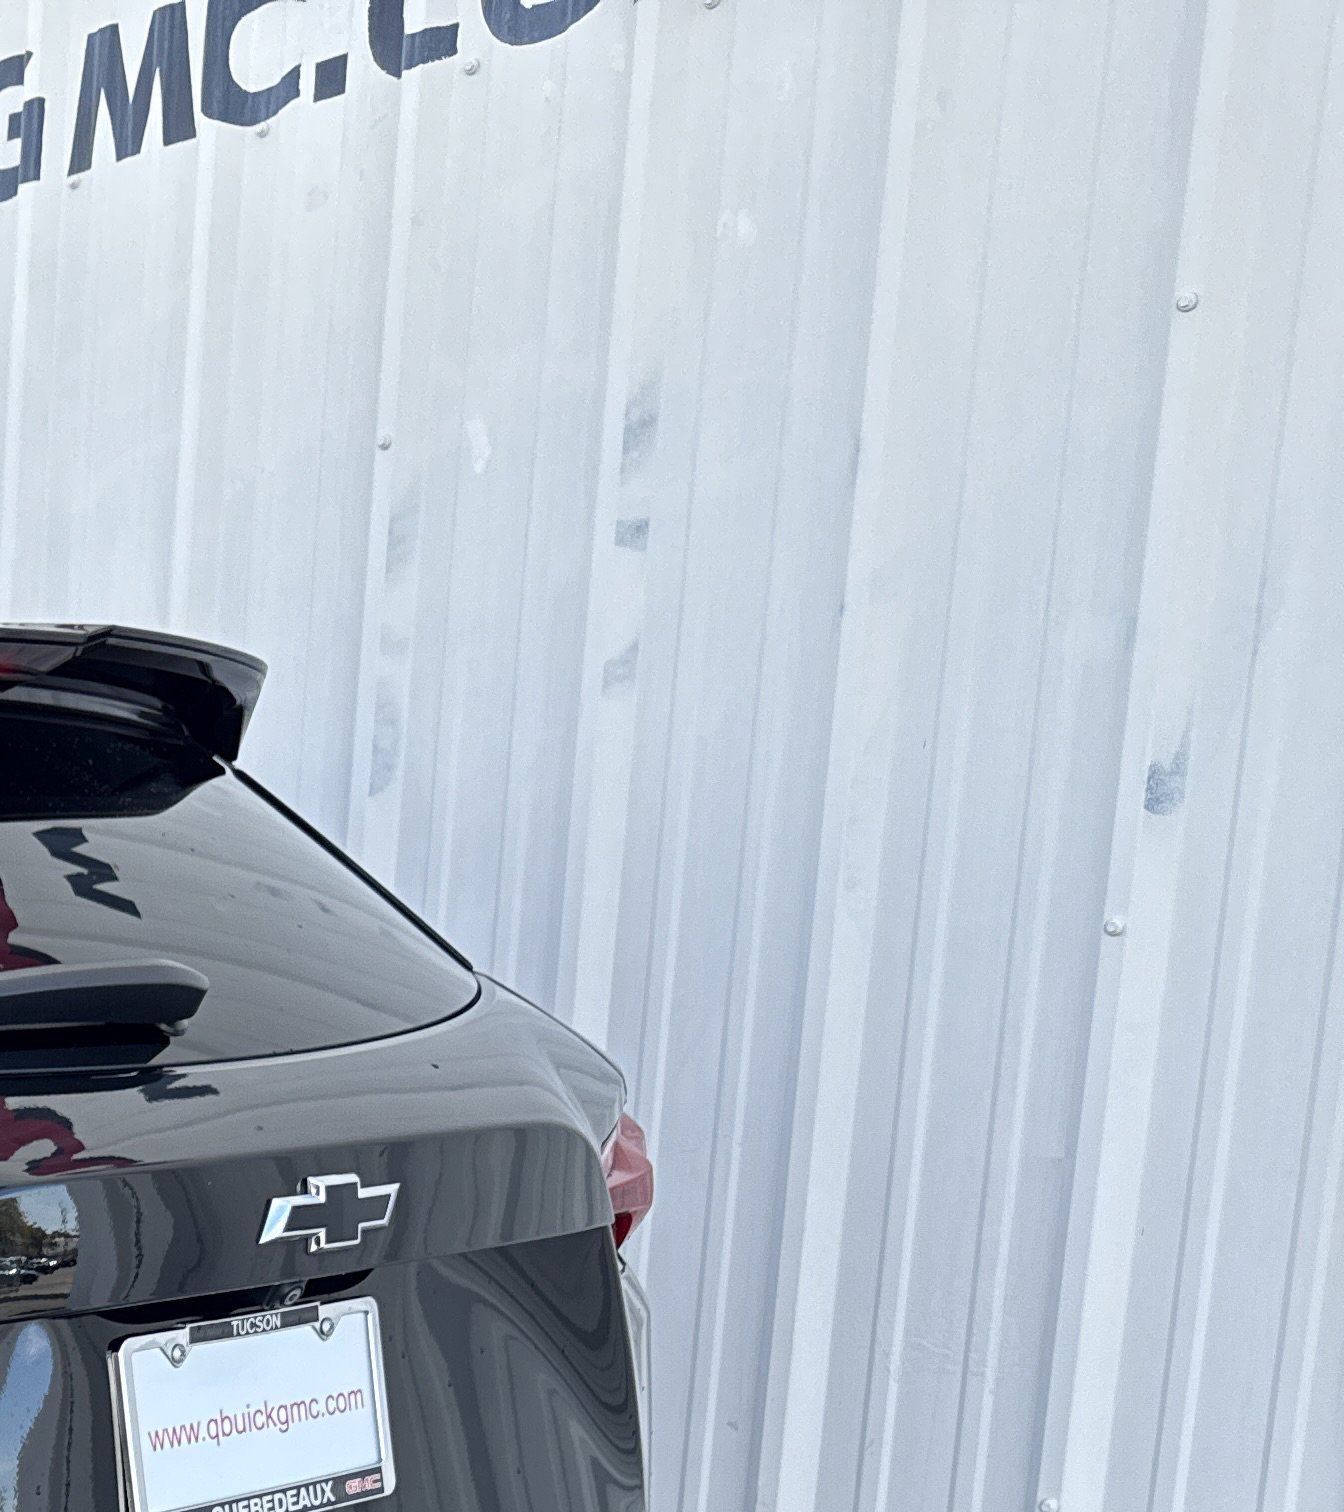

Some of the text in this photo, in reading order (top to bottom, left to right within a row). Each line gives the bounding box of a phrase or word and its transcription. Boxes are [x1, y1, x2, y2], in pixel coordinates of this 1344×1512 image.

[230, 1312, 282, 1337] TUCSON
[147, 1386, 366, 1453] www.qbuickgmc.com
[345, 1473, 382, 1496] GMC
